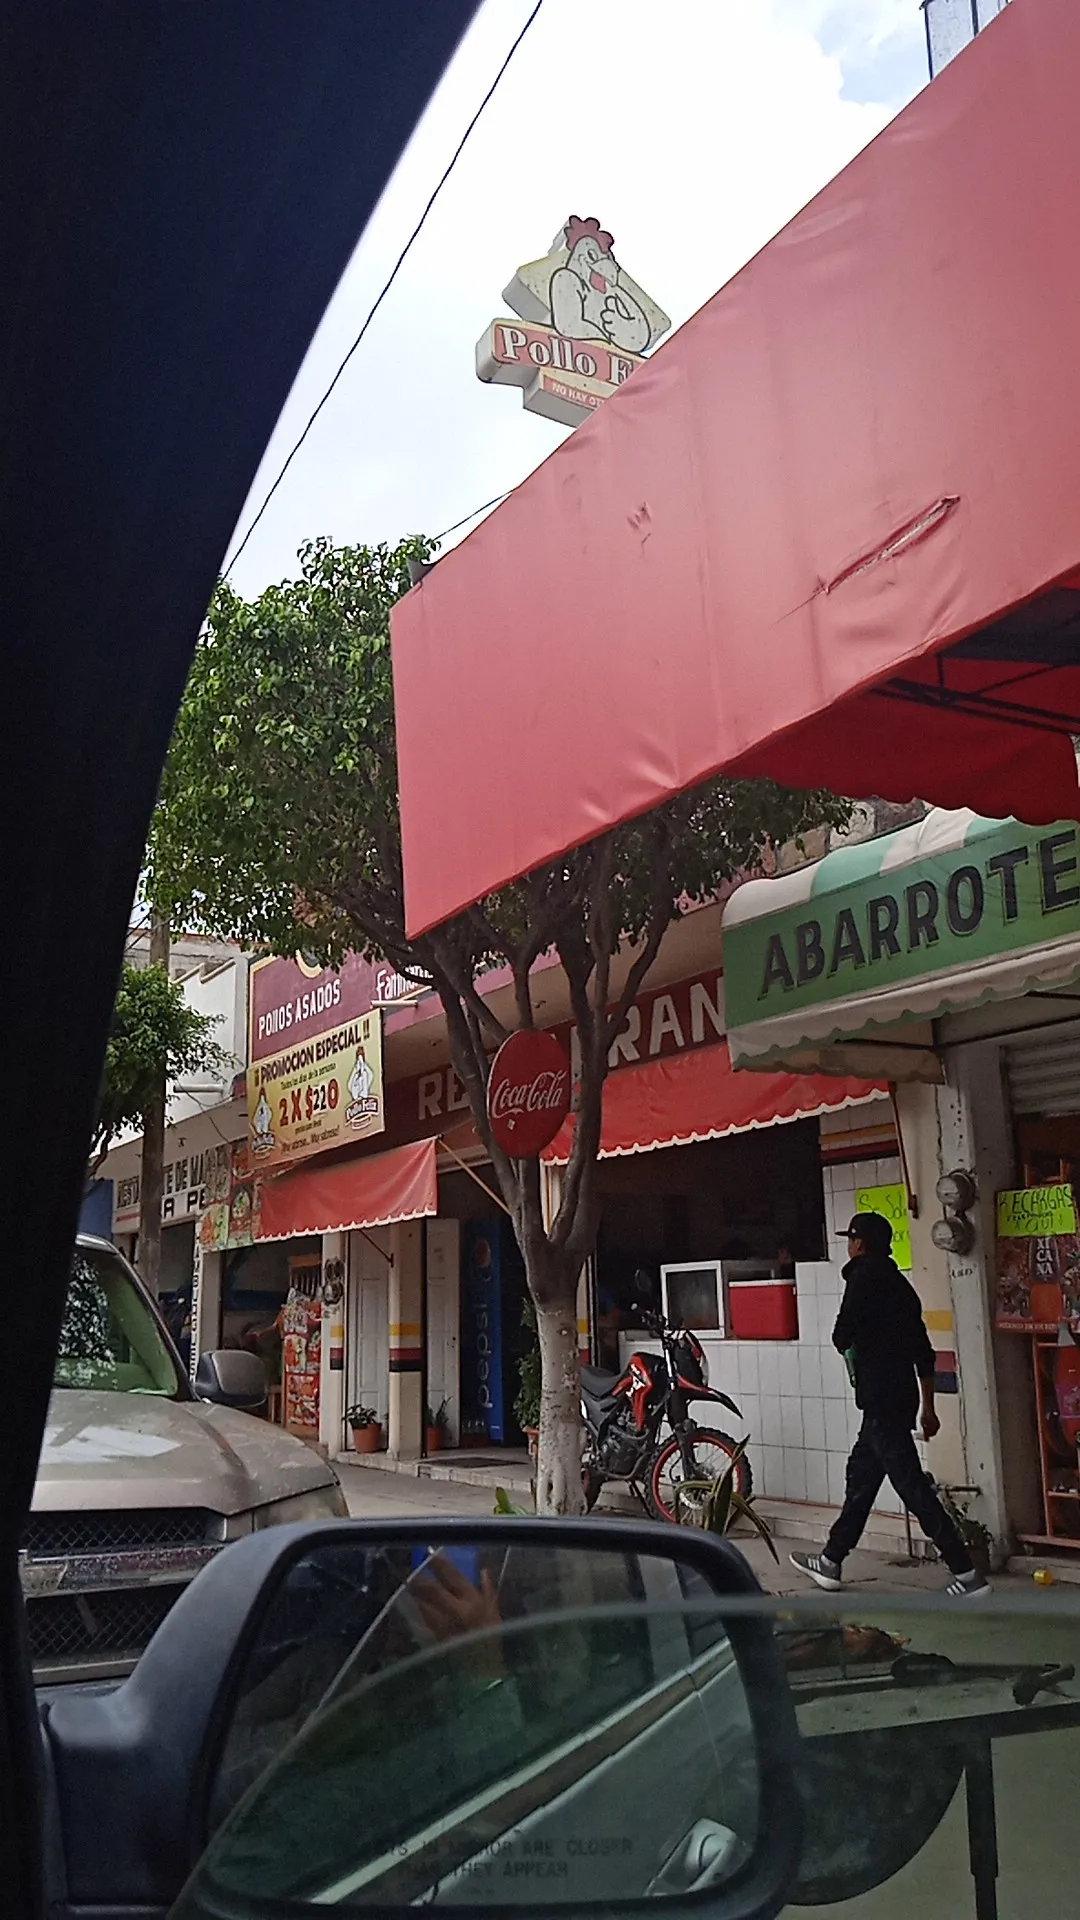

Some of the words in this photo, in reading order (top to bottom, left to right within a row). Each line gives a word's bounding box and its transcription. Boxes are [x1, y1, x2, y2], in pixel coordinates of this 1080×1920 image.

[500, 326, 597, 377] Pollo
[552, 382, 566, 396] NO
[568, 388, 587, 403] HAY
[757, 829, 1080, 1000] ABARROTE
[295, 979, 340, 1023] ASADOS
[316, 1024, 361, 1061] ESPECIAL
[279, 1098, 289, 1127] 2
[305, 1078, 339, 1121] $220
[492, 1070, 567, 1119] Coca-Cola
[477, 1303, 493, 1409] pepsi
